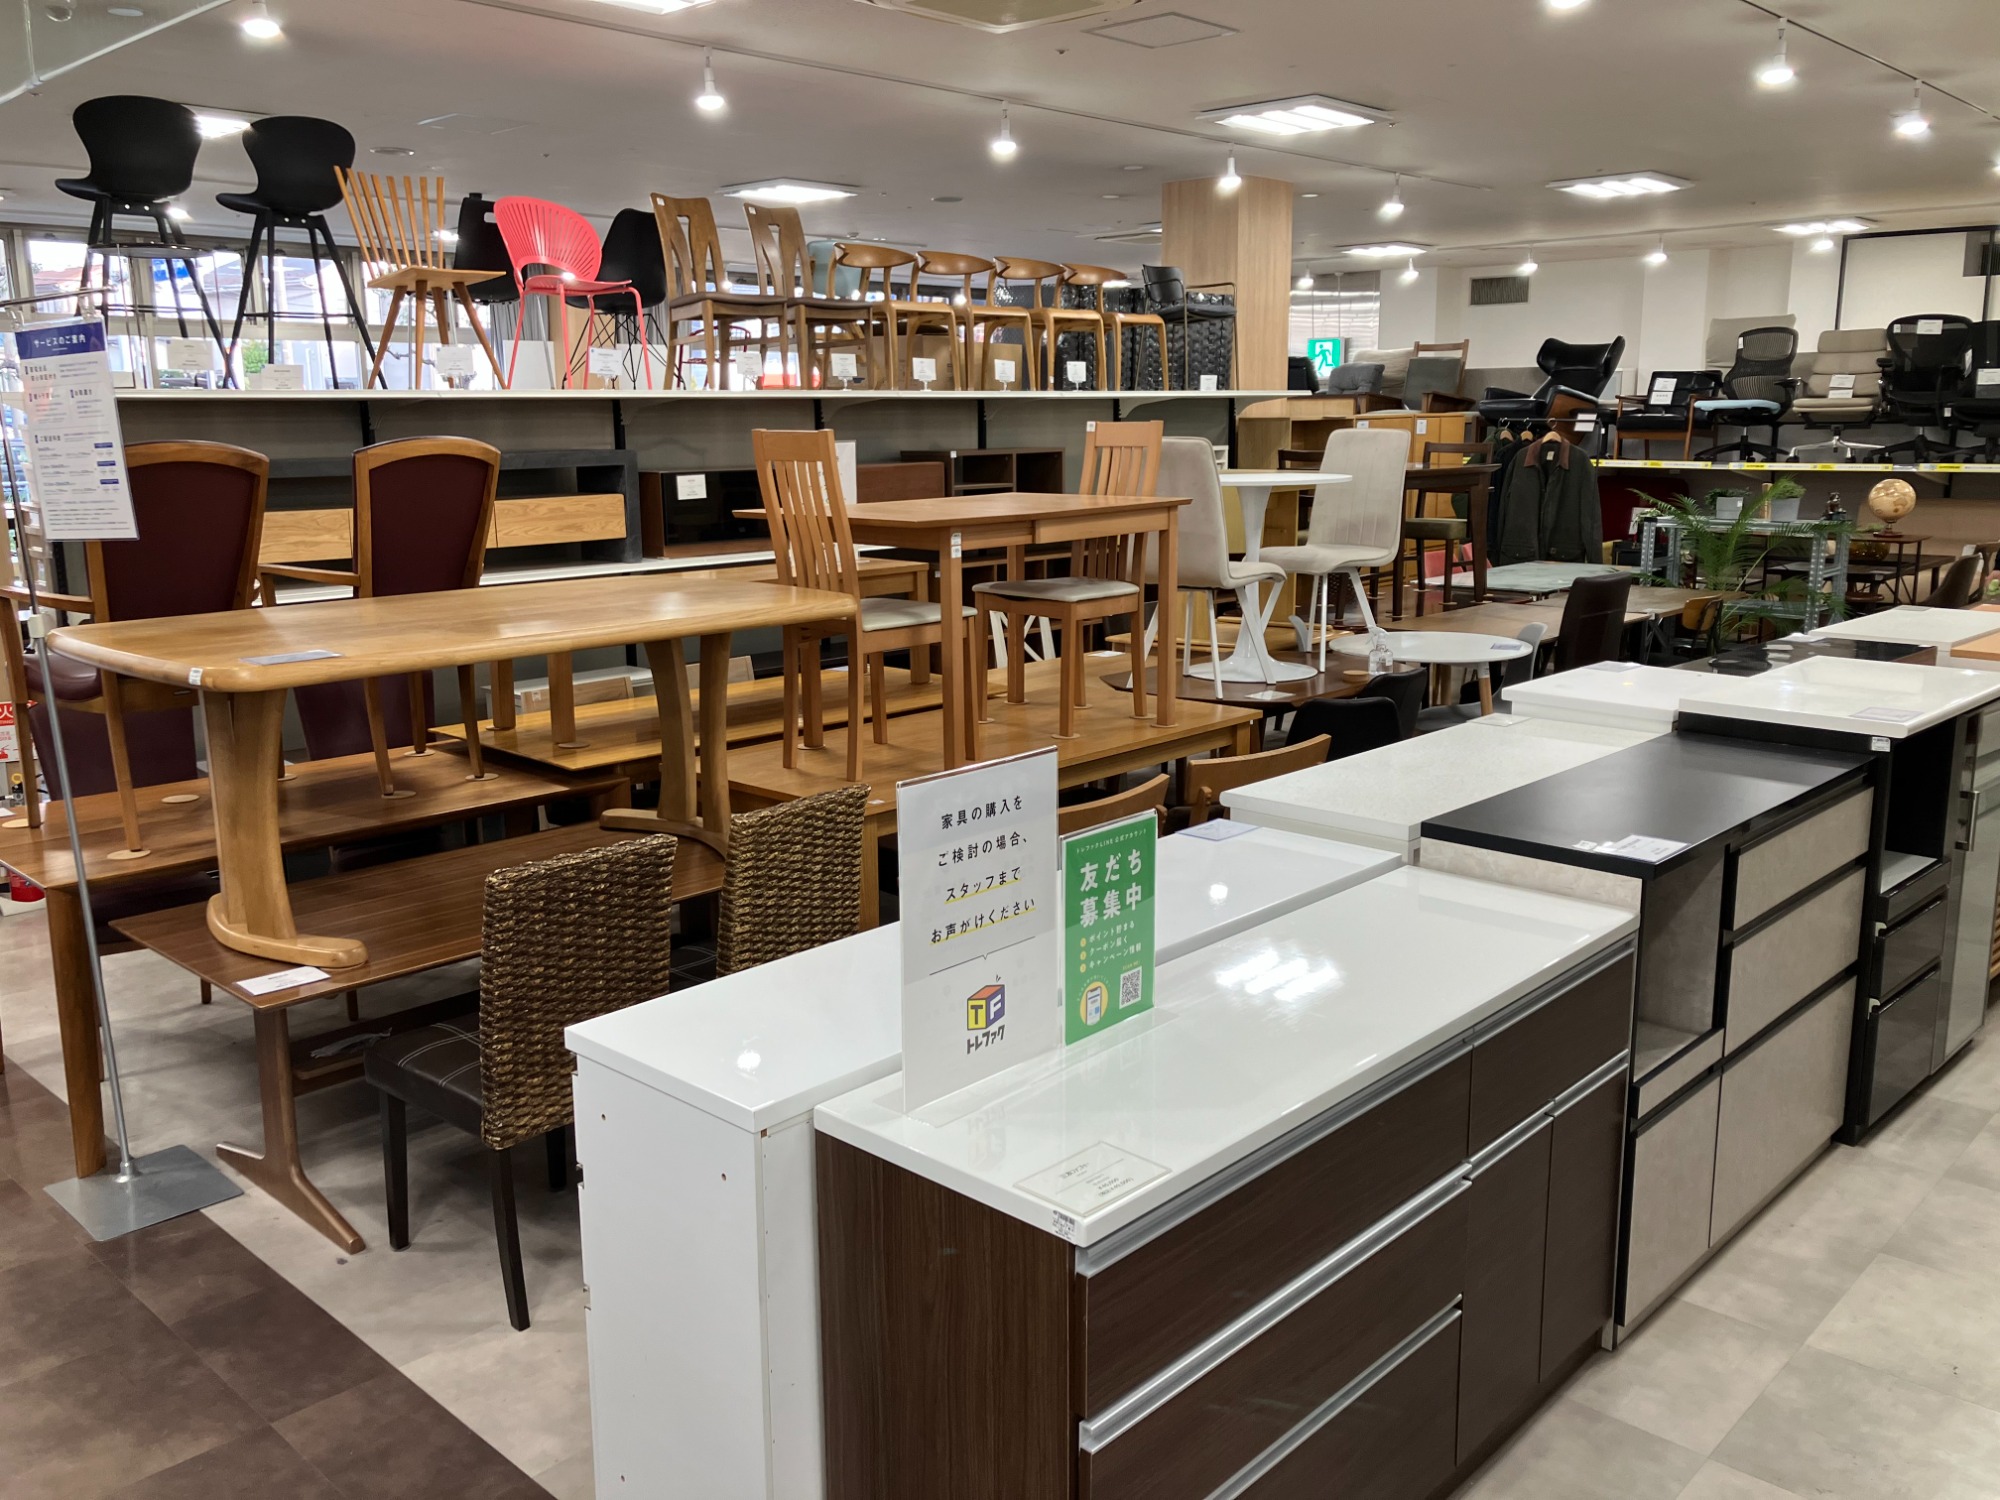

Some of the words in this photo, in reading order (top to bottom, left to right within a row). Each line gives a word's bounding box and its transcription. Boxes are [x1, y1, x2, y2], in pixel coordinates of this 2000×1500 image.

[941, 795, 1022, 830] 家具の購入を
[938, 831, 1027, 867] ご検討の場合、
[946, 867, 1021, 902] スタッフまで
[1080, 849, 1142, 892] 友だち
[931, 899, 1035, 944] お声がけください
[1080, 882, 1142, 928] 募集中
[967, 1024, 1006, 1055] トレファク
